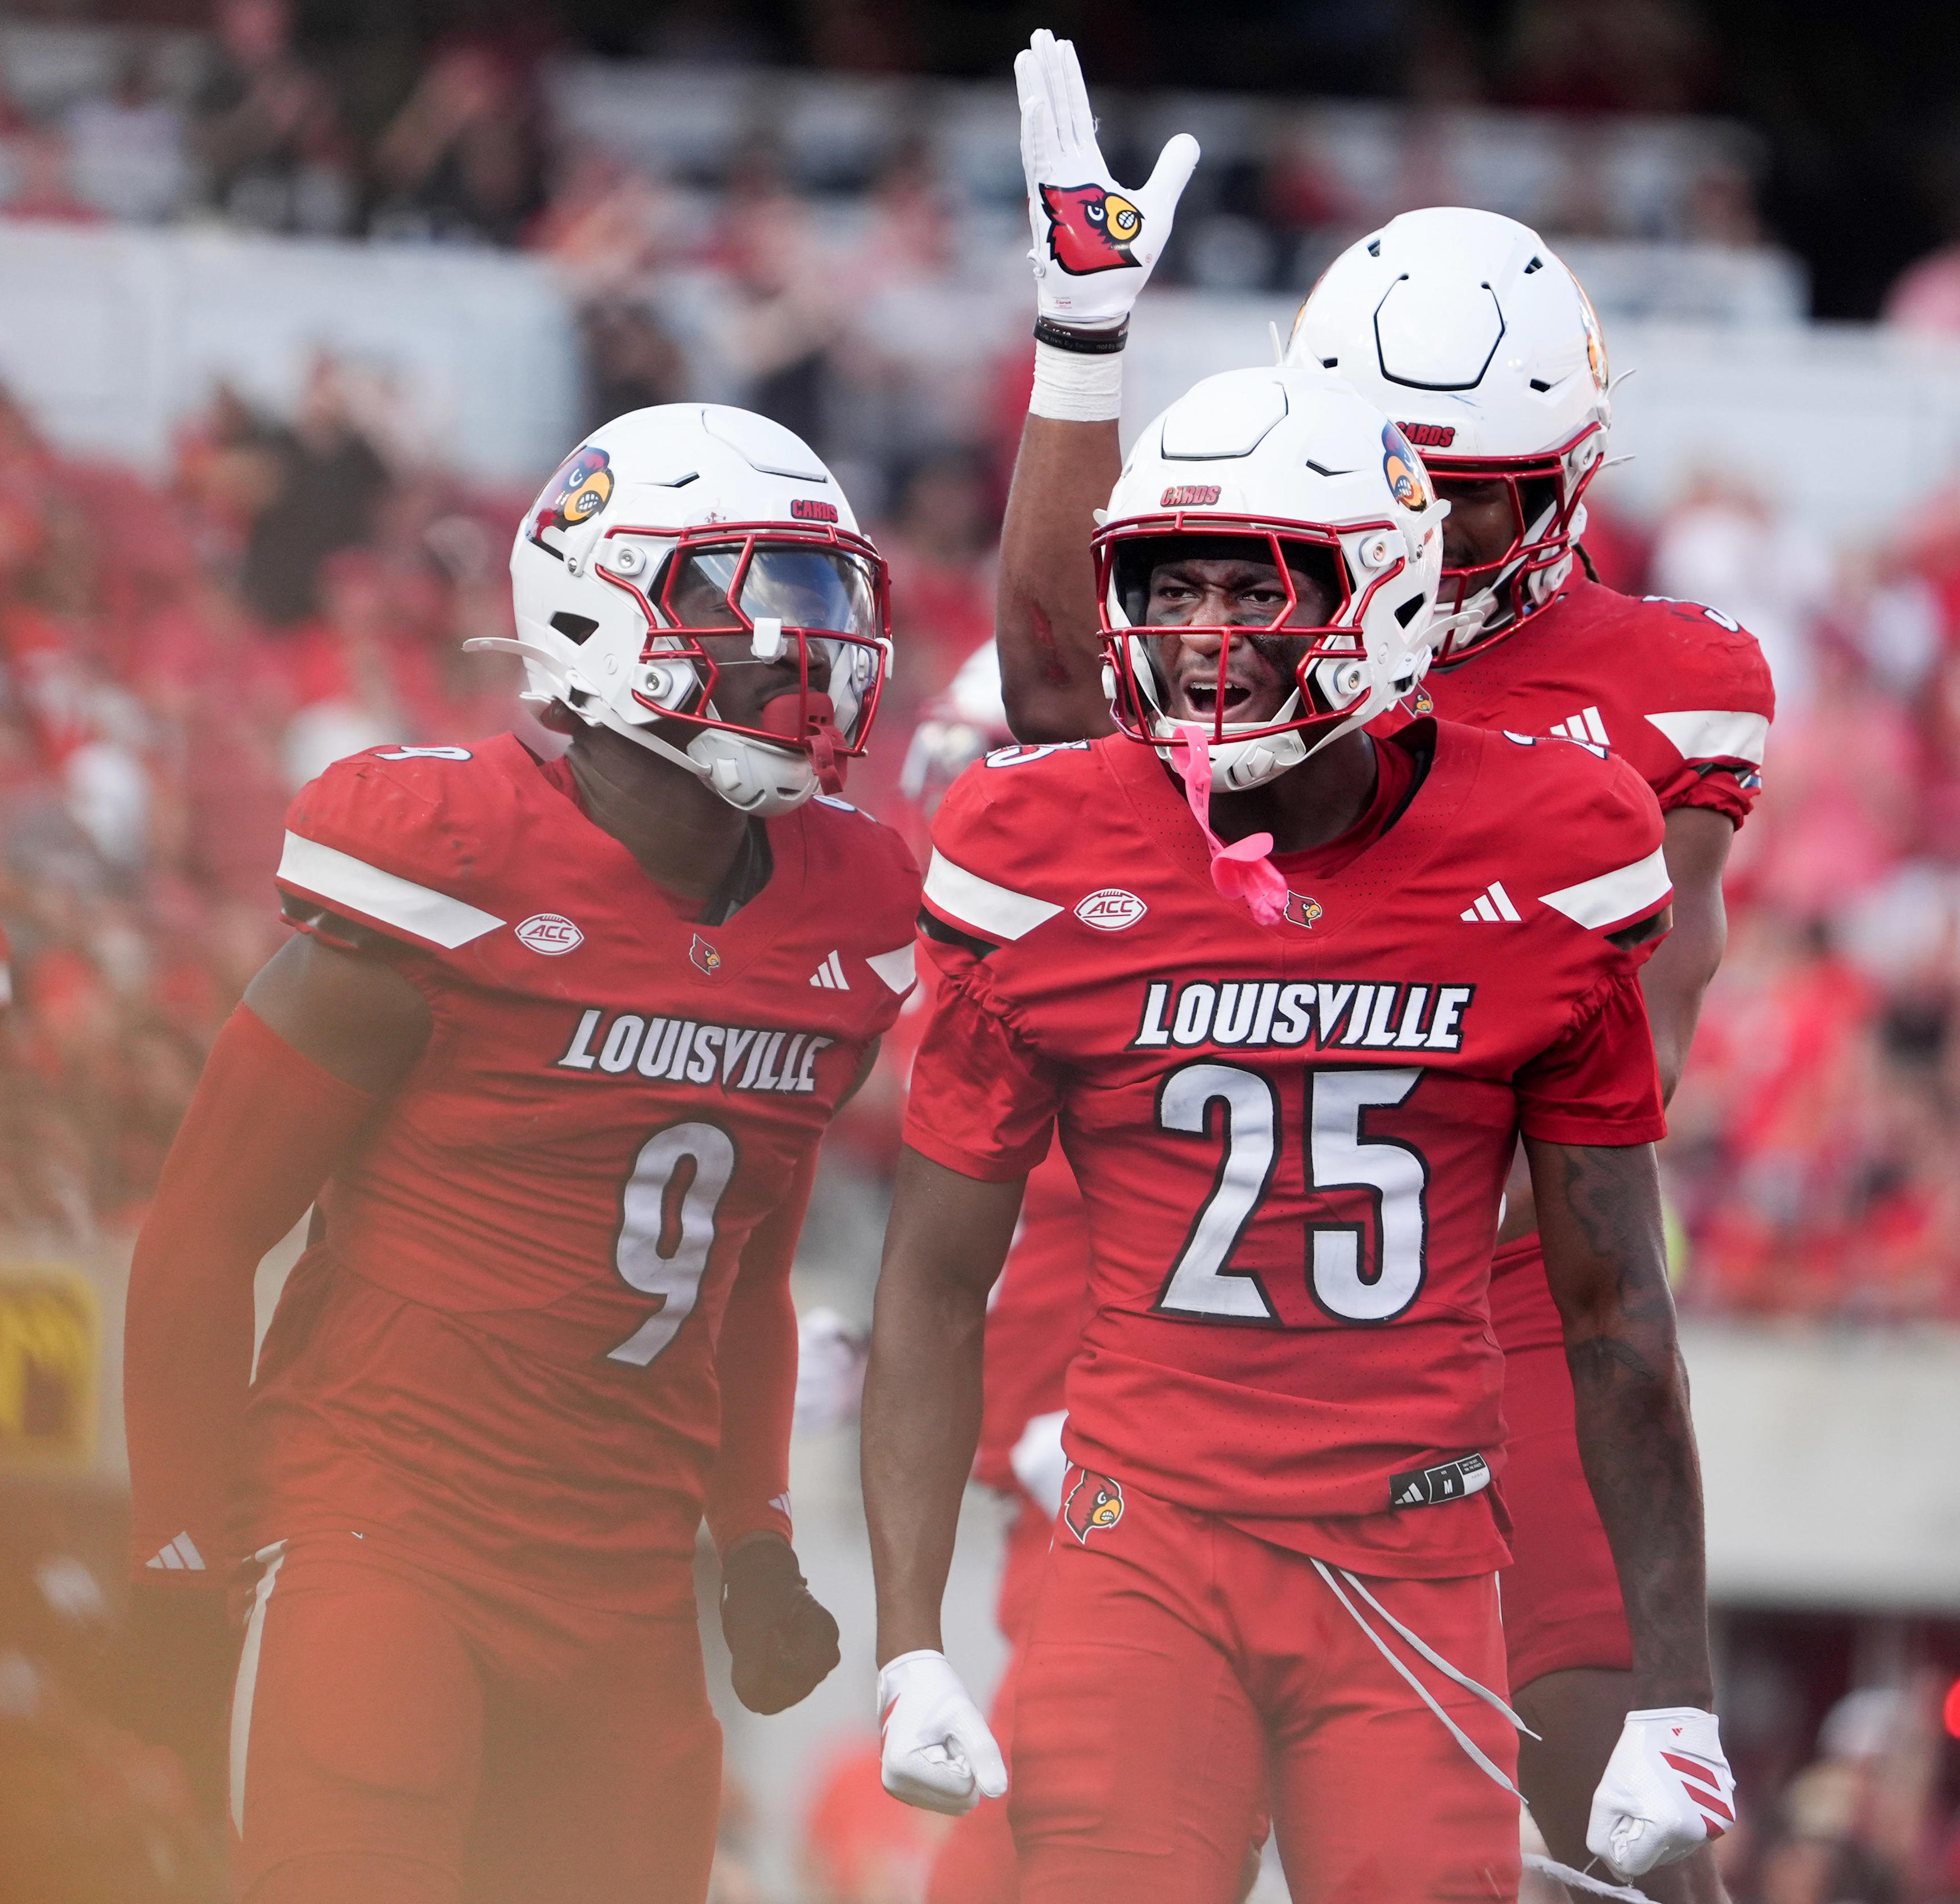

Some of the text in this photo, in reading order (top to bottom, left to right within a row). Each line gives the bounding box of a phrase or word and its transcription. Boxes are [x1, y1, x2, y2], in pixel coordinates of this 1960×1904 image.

[1160, 485, 1221, 507] CARDS
[791, 499, 838, 523] CARDS
[1087, 900, 1135, 915] ACC
[526, 924, 573, 940] ACC
[1132, 982, 1473, 1049] LOUISVILLE
[558, 1009, 835, 1092] LOUISVILLE
[1159, 1063, 1426, 1320] 25
[606, 1122, 735, 1367] 9
[1443, 1479, 1453, 1495] M
